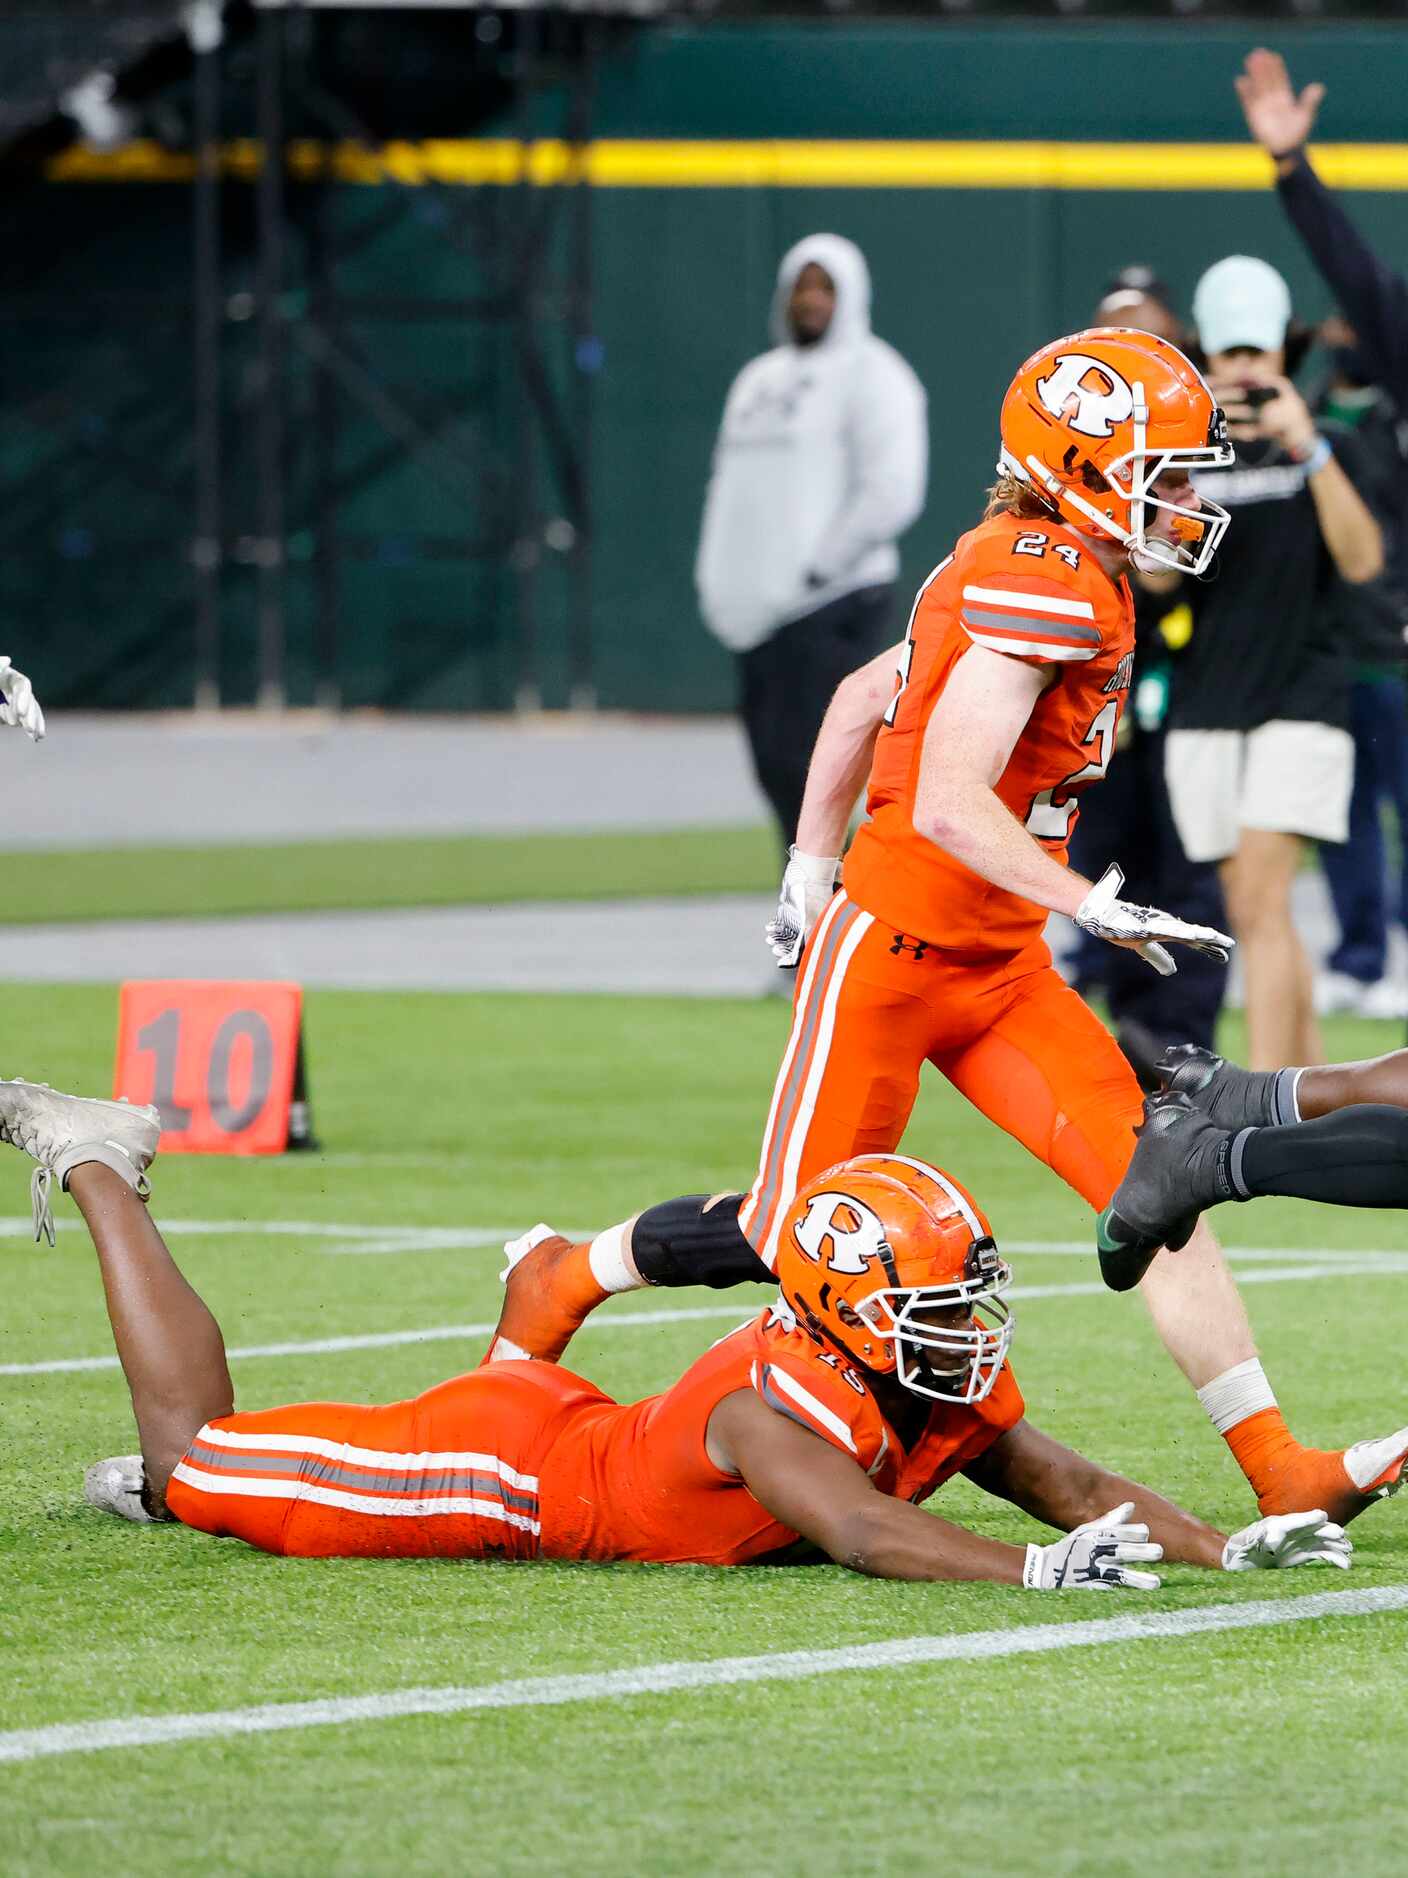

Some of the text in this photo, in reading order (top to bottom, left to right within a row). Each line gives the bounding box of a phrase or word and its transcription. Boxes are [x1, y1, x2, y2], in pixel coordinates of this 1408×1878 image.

[1036, 353, 1134, 439] R
[1011, 530, 1081, 572] 24
[136, 1008, 274, 1133] 10
[793, 1191, 886, 1276] R
